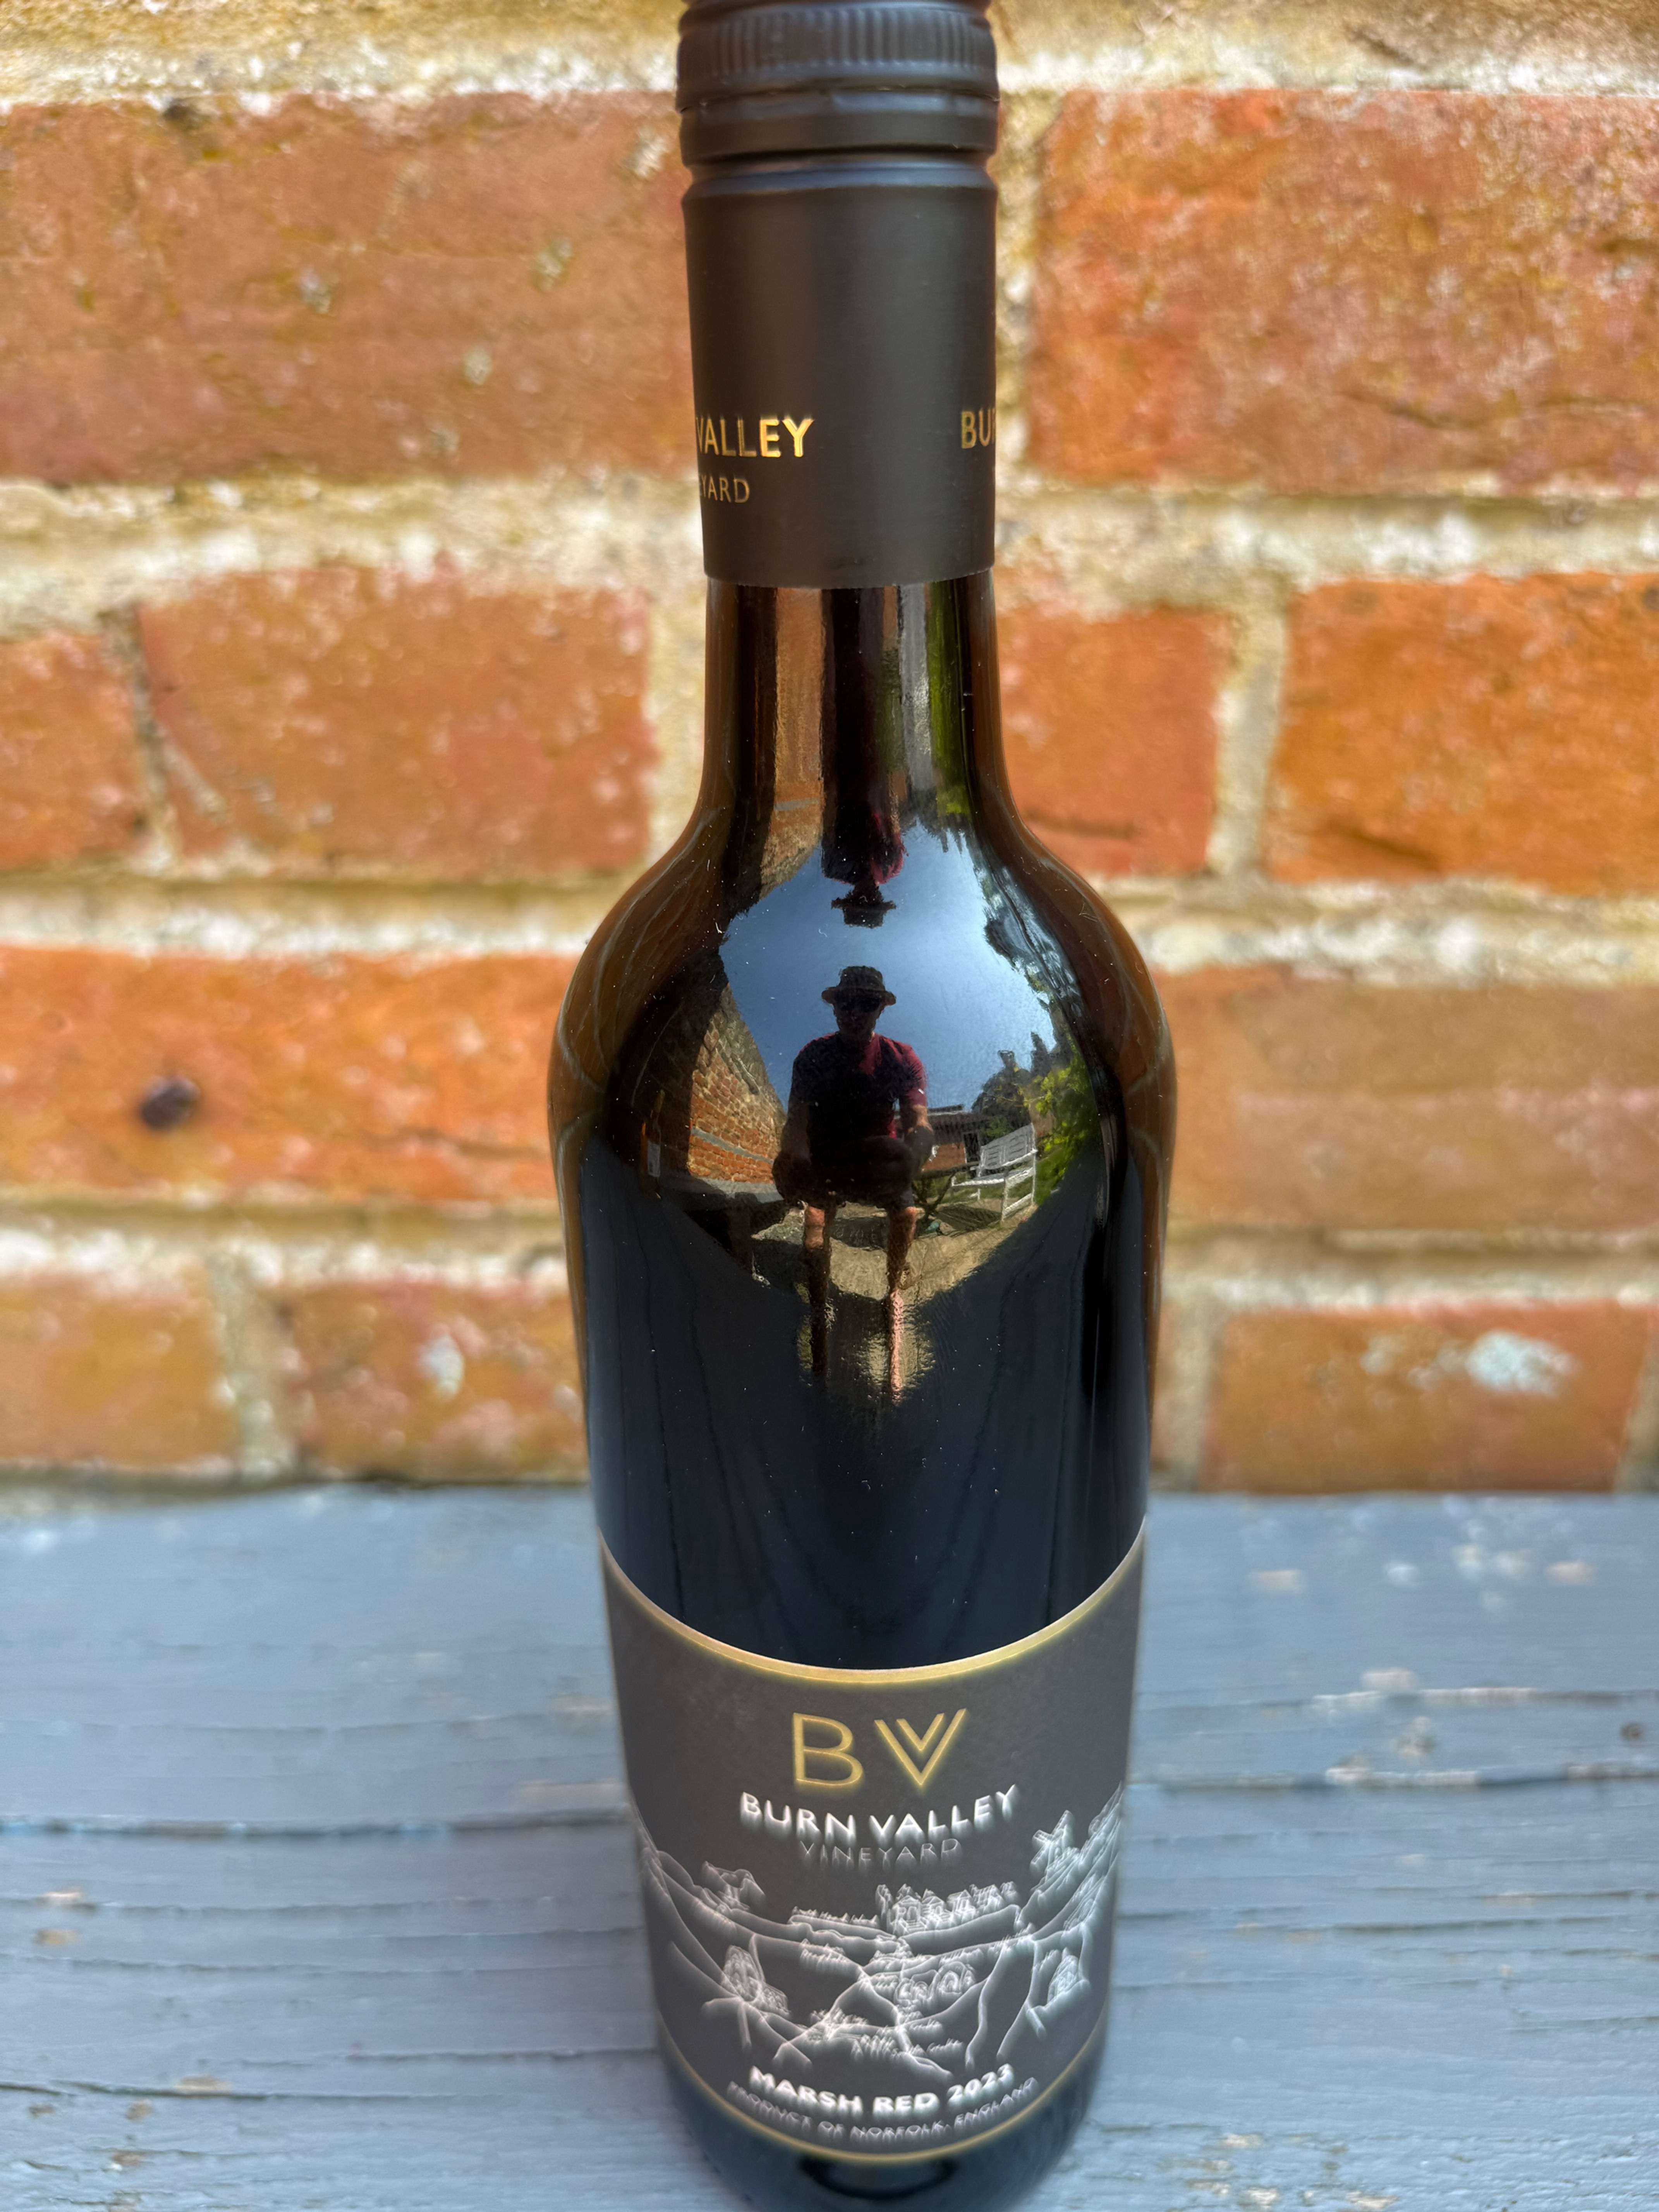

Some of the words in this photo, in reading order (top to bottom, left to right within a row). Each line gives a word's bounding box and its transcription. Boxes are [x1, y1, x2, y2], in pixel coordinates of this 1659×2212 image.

[696, 415, 814, 458] VALLEY
[699, 473, 750, 503] YARD
[740, 1791, 856, 1844] BURN
[869, 1784, 1018, 1844] VALLEY
[799, 1838, 962, 1870] VINEYARD
[749, 2065, 864, 2118] MARSH
[872, 2092, 941, 2119] RED
[817, 2121, 845, 2140] OF
